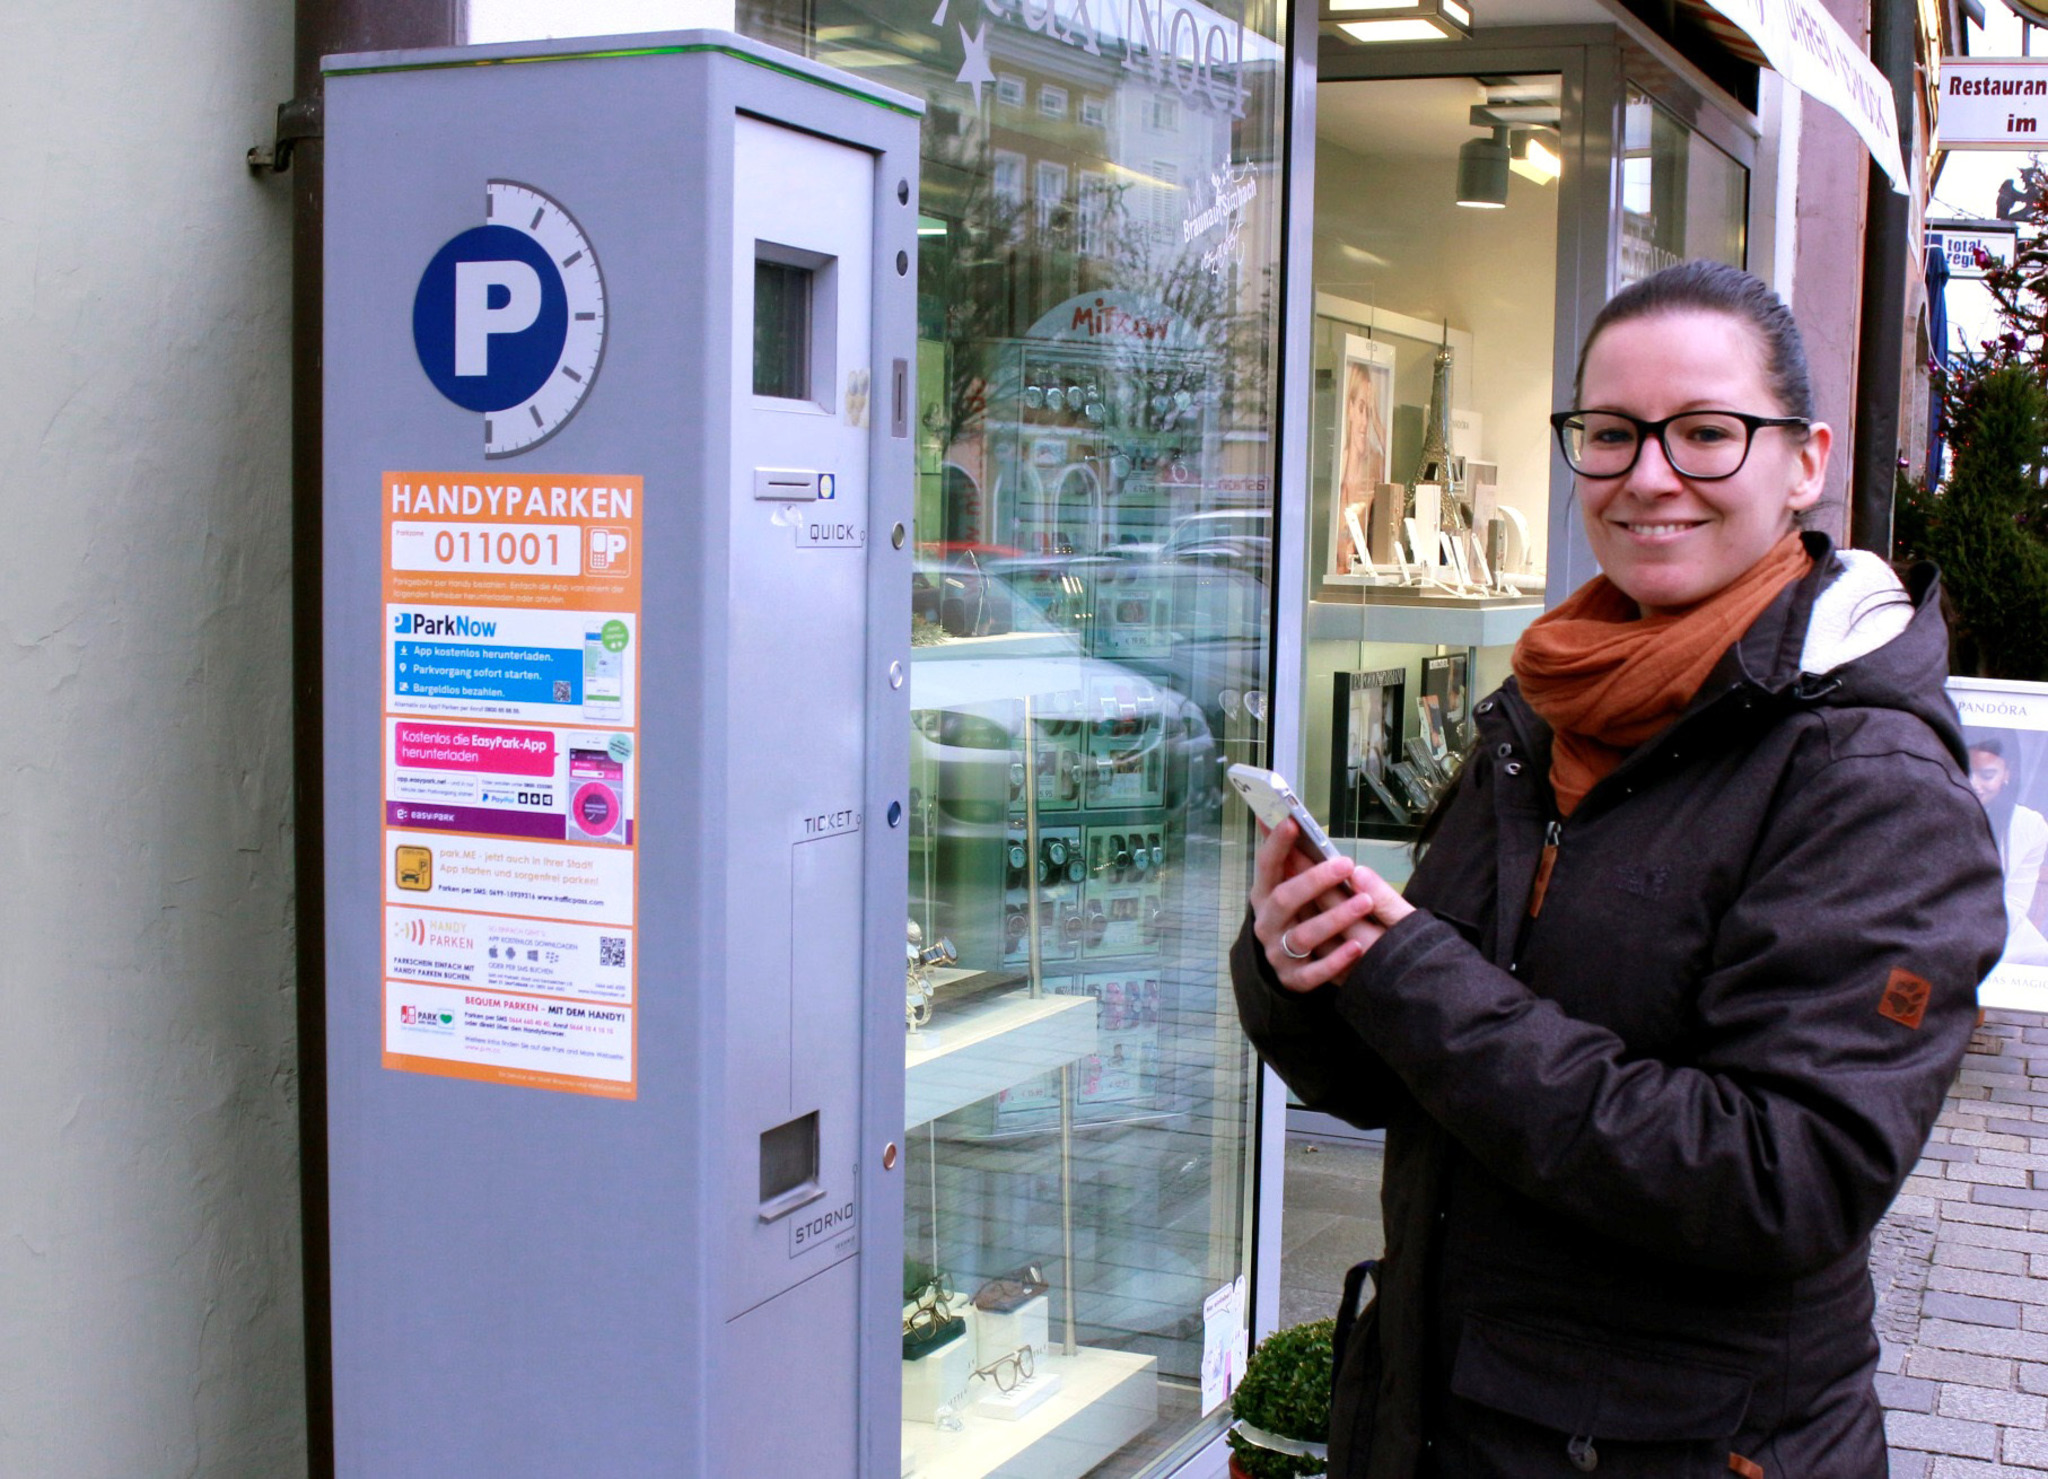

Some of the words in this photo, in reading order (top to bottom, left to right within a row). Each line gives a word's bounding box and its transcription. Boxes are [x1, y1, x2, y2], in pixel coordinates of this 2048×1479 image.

[1949, 76, 2047, 96] Restauran
[2007, 114, 2036, 132] im
[1183, 204, 1219, 244] Braunau
[1223, 176, 1257, 217] Simbach
[1946, 253, 2005, 269] regil
[455, 260, 542, 377] P
[392, 484, 632, 519] HANDYPARKEN
[810, 524, 854, 543] QUICK
[434, 530, 558, 566] 011001
[413, 614, 497, 637] ParkNow
[414, 645, 433, 660] App
[434, 646, 480, 659] kostenlos
[482, 649, 554, 662] herunterladen.
[413, 664, 472, 679] Parkvorgang
[473, 667, 502, 679] sofort
[504, 669, 542, 681] starten.
[413, 683, 460, 697] Bargeldlos
[462, 685, 506, 698] bezahlen.
[402, 730, 451, 745] Kostenlos
[453, 733, 471, 746] die
[472, 735, 547, 751] EasyPark-App
[402, 746, 479, 763] herunterladen
[804, 810, 852, 834] TICKET
[439, 849, 477, 861] park.ME
[484, 853, 503, 864] jetzt
[506, 854, 529, 865] auch
[543, 856, 564, 868] Ihrer
[439, 863, 459, 876] App
[460, 866, 492, 877] starten
[494, 867, 512, 878] und
[514, 870, 560, 882] sorgenfrei
[562, 872, 599, 886] parken!
[438, 884, 460, 893] Parken
[461, 887, 472, 895] per
[429, 920, 467, 933] HANDY
[429, 935, 474, 949] PARKEN
[393, 956, 433, 968] PARKSCHEIN
[434, 960, 464, 971] EINFACH
[464, 963, 475, 972] MIT
[393, 966, 416, 976] HANDY
[417, 968, 442, 978] PARKEN
[417, 1011, 437, 1021] PARK
[464, 1011, 484, 1021] Parken
[485, 1014, 495, 1023] per
[496, 1014, 508, 1023] SMS
[465, 996, 501, 1008] BEQUEM
[503, 1000, 539, 1013] PARKEN
[548, 1005, 564, 1016] MIT
[566, 1007, 586, 1018] DEM
[588, 1009, 626, 1023] HANDY!
[795, 1202, 853, 1244] STORNO
